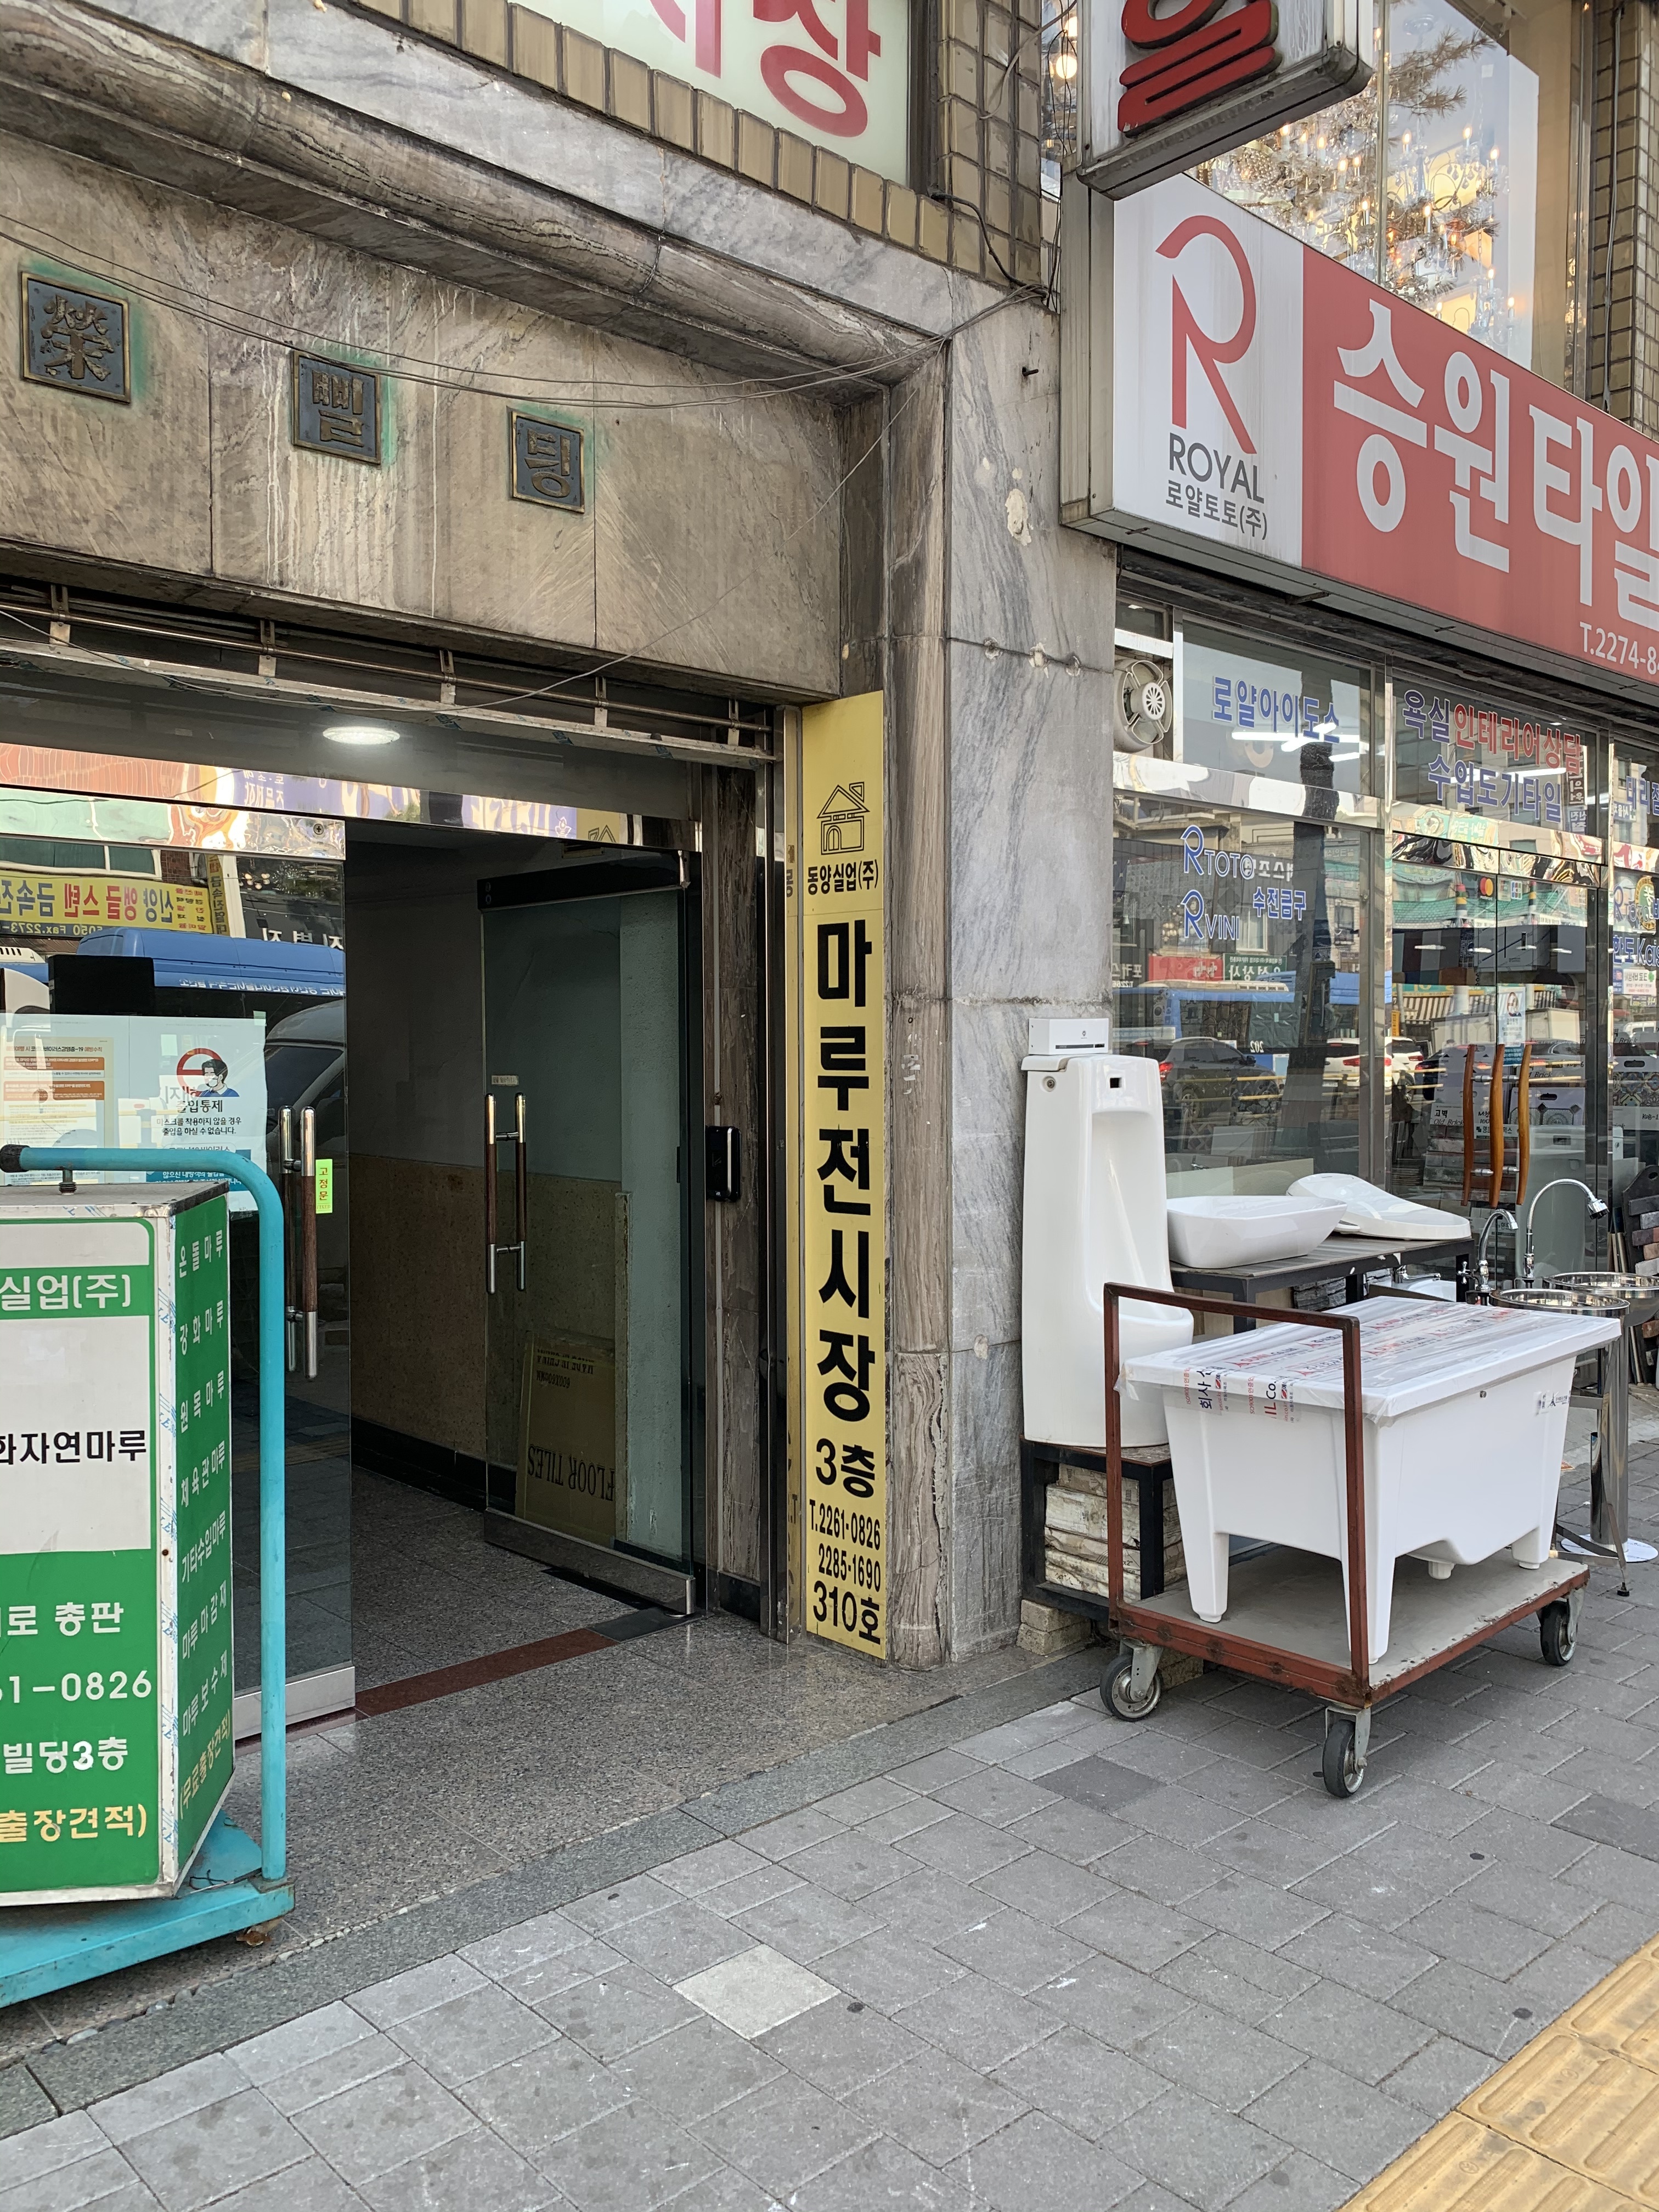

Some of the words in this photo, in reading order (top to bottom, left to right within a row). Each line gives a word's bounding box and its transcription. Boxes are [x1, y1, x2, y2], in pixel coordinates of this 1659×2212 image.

[1169, 432, 1265, 504] ROYAL
[1334, 299, 1659, 631] 승원타일
[1166, 479, 1267, 540] 로얄토토(주)
[1579, 621, 1659, 675] T.2274-8
[1212, 675, 1340, 745] 로얄아이도스
[1427, 754, 1562, 824] 수입도기타일
[808, 859, 878, 895] 동양실업(주)
[1252, 887, 1306, 921] 수전금구
[156, 1118, 184, 1126] 마스크를
[162, 1127, 183, 1136] 출입을
[184, 1127, 198, 1135] 하실
[207, 1126, 236, 1135] 없습니다.
[176, 1100, 223, 1113] 출입통제
[319, 1167, 328, 1201] 고정문
[816, 919, 876, 1423] 마루전시장
[179, 1229, 223, 1278] 온돌마루
[0, 1274, 131, 1311] 실업(주)
[180, 1300, 223, 1356] 강화마루
[180, 1370, 224, 1434] 원목마루
[527, 1444, 563, 1487] TILES
[568, 1455, 616, 1502] FLOOR
[816, 1437, 876, 1498] 3층
[182, 1510, 226, 1583] 기타수입마루
[809, 1498, 881, 1551] T.2261-0826
[819, 1543, 881, 1593] 2285-1690
[0, 1606, 38, 1637] 로
[55, 1601, 125, 1637] 총판
[812, 1580, 881, 1645] 310호
[0, 1670, 152, 1703] 1-0826
[3, 1736, 128, 1775] 빌딩3층
[180, 1709, 230, 1820] (무료출장견적)
[0, 1803, 147, 1843] 출장견적)
